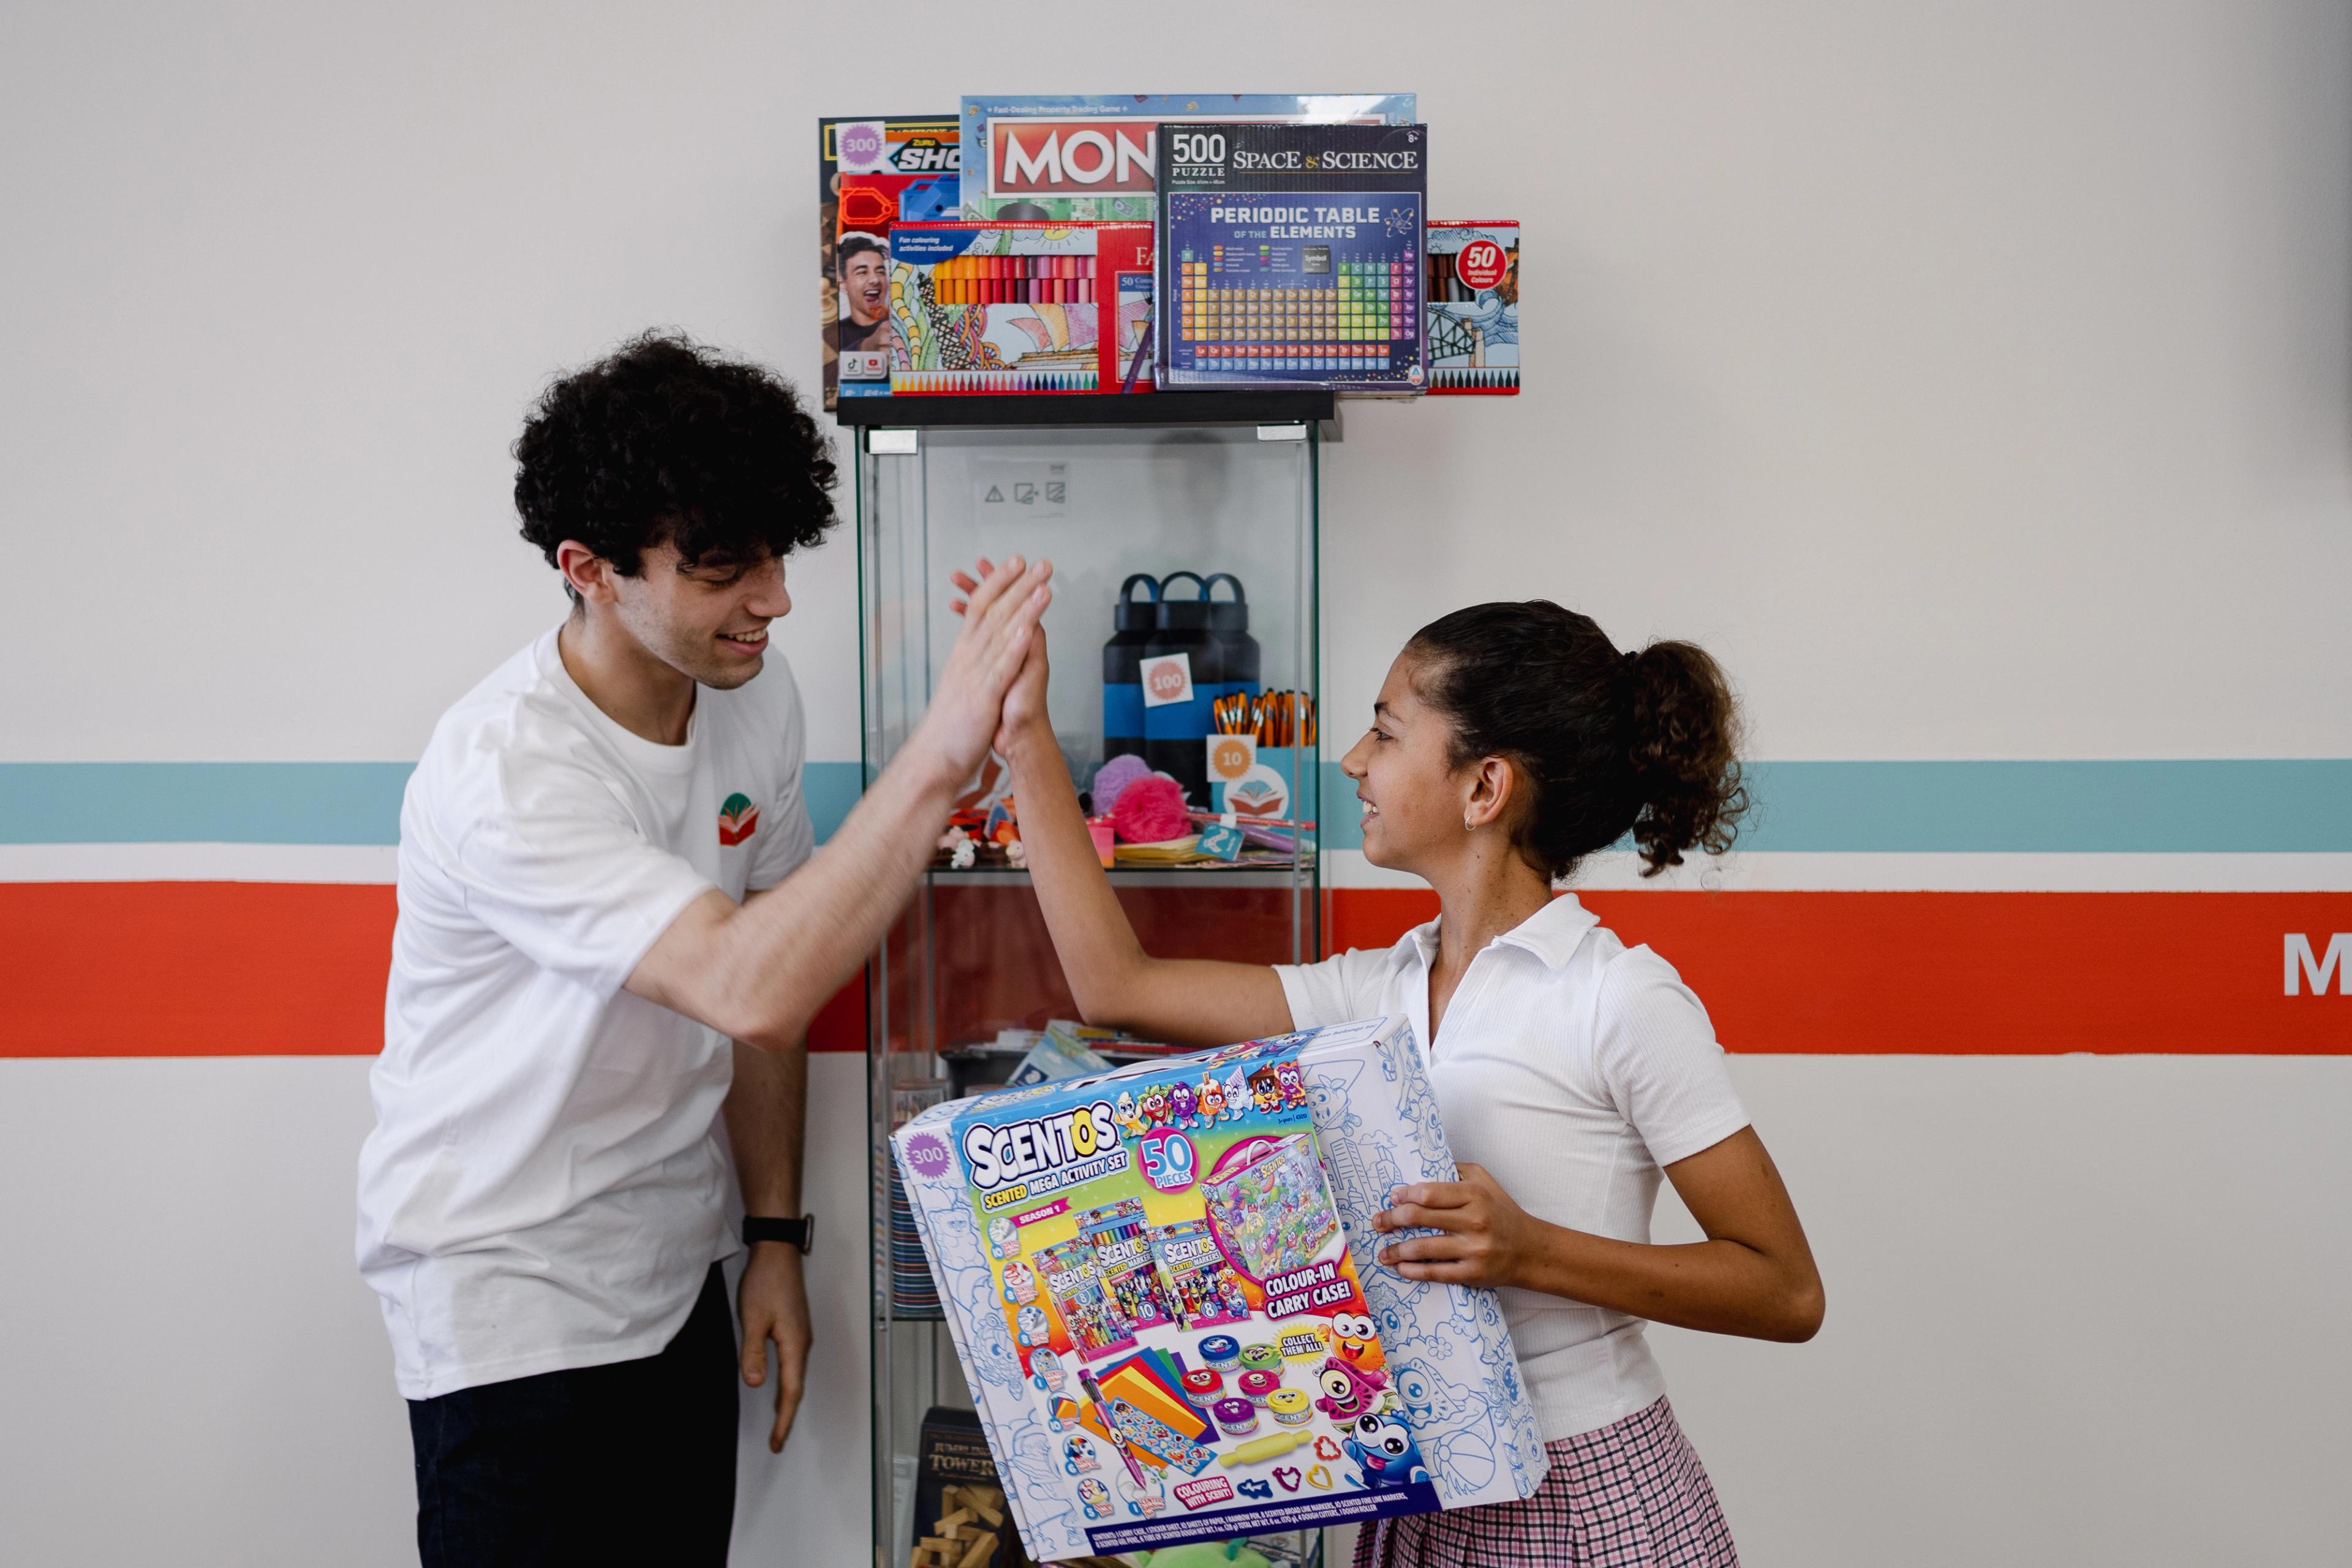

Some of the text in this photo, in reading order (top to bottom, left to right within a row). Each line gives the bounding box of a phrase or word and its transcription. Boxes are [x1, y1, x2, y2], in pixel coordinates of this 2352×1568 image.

[1071, 105, 1099, 114] Trading
[846, 138, 876, 152] 300
[1408, 134, 1419, 143] 8+
[1003, 129, 1156, 184] MON
[1173, 134, 1225, 162] 500
[1233, 151, 1419, 168] SPACE & SCIENCE
[1172, 168, 1225, 176] PUZZLE
[1211, 208, 1380, 224] PERIODIC TABLE
[1270, 226, 1356, 238] ELEMENTS
[1467, 246, 1496, 268] 50
[1122, 277, 1133, 286] 50
[1154, 673, 1182, 690] 100
[1223, 753, 1242, 766] 10
[2283, 932, 2352, 996] M
[966, 1102, 1117, 1187] SCENTOS
[911, 1147, 944, 1164] 300
[1141, 1134, 1191, 1177] 50
[1261, 1153, 1286, 1178] SCENTOS
[984, 1153, 1126, 1209] SCENTED MEGA ACTIVITY SET
[1156, 1172, 1191, 1188] PIECES
[1019, 1207, 1054, 1224] SEASON
[1096, 1235, 1150, 1267] SCENTOS
[1164, 1235, 1216, 1264] SCENTOS
[1105, 1252, 1154, 1278] SCENTED MARKERS
[1170, 1253, 1219, 1273] SCENTED MARKERS
[1048, 1260, 1096, 1294] SCENTOS
[1266, 1263, 1336, 1297] COLOUR-IN
[1080, 1294, 1087, 1303] 8
[1267, 1281, 1351, 1318] CARRY CASE!
[1139, 1305, 1153, 1317] 10
[1204, 1302, 1215, 1316] 8
[1281, 1341, 1324, 1356] THEM ALL!
[1283, 1333, 1315, 1347] COLLECT
[1205, 1358, 1240, 1369] SCENTOS
[1189, 1390, 1224, 1403] SCENTOS
[1275, 1410, 1310, 1421] SCENTOS
[929, 1455, 995, 1476] TOWER
[1177, 1478, 1228, 1498] COLOURING
[1185, 1488, 1232, 1507] WITH SCENT!
[1092, 1532, 1117, 1541] CONTENTS:
[1118, 1529, 1134, 1538] CARRY
[1148, 1525, 1167, 1533] STICKER
[1186, 1520, 1204, 1528] SHEETS
[1227, 1513, 1250, 1523] RAINBOW
[1265, 1509, 1285, 1518] SCENTED
[1284, 1506, 1301, 1515] BROAD
[1341, 1498, 1362, 1507] SCENTED
[1382, 1492, 1408, 1502] MARKERS,
[1099, 1539, 1119, 1548] SCENTED
[1161, 1530, 1181, 1539] SCENTED
[1180, 1528, 1197, 1537] DOUGH
[1237, 1520, 1252, 1529] TOTAL
[1302, 1512, 1319, 1520] DOUGH
[1318, 1508, 1341, 1518] CUTTERS,
[1342, 1507, 1360, 1515] DOUGH
[1359, 1504, 1378, 1513] ROLLER
